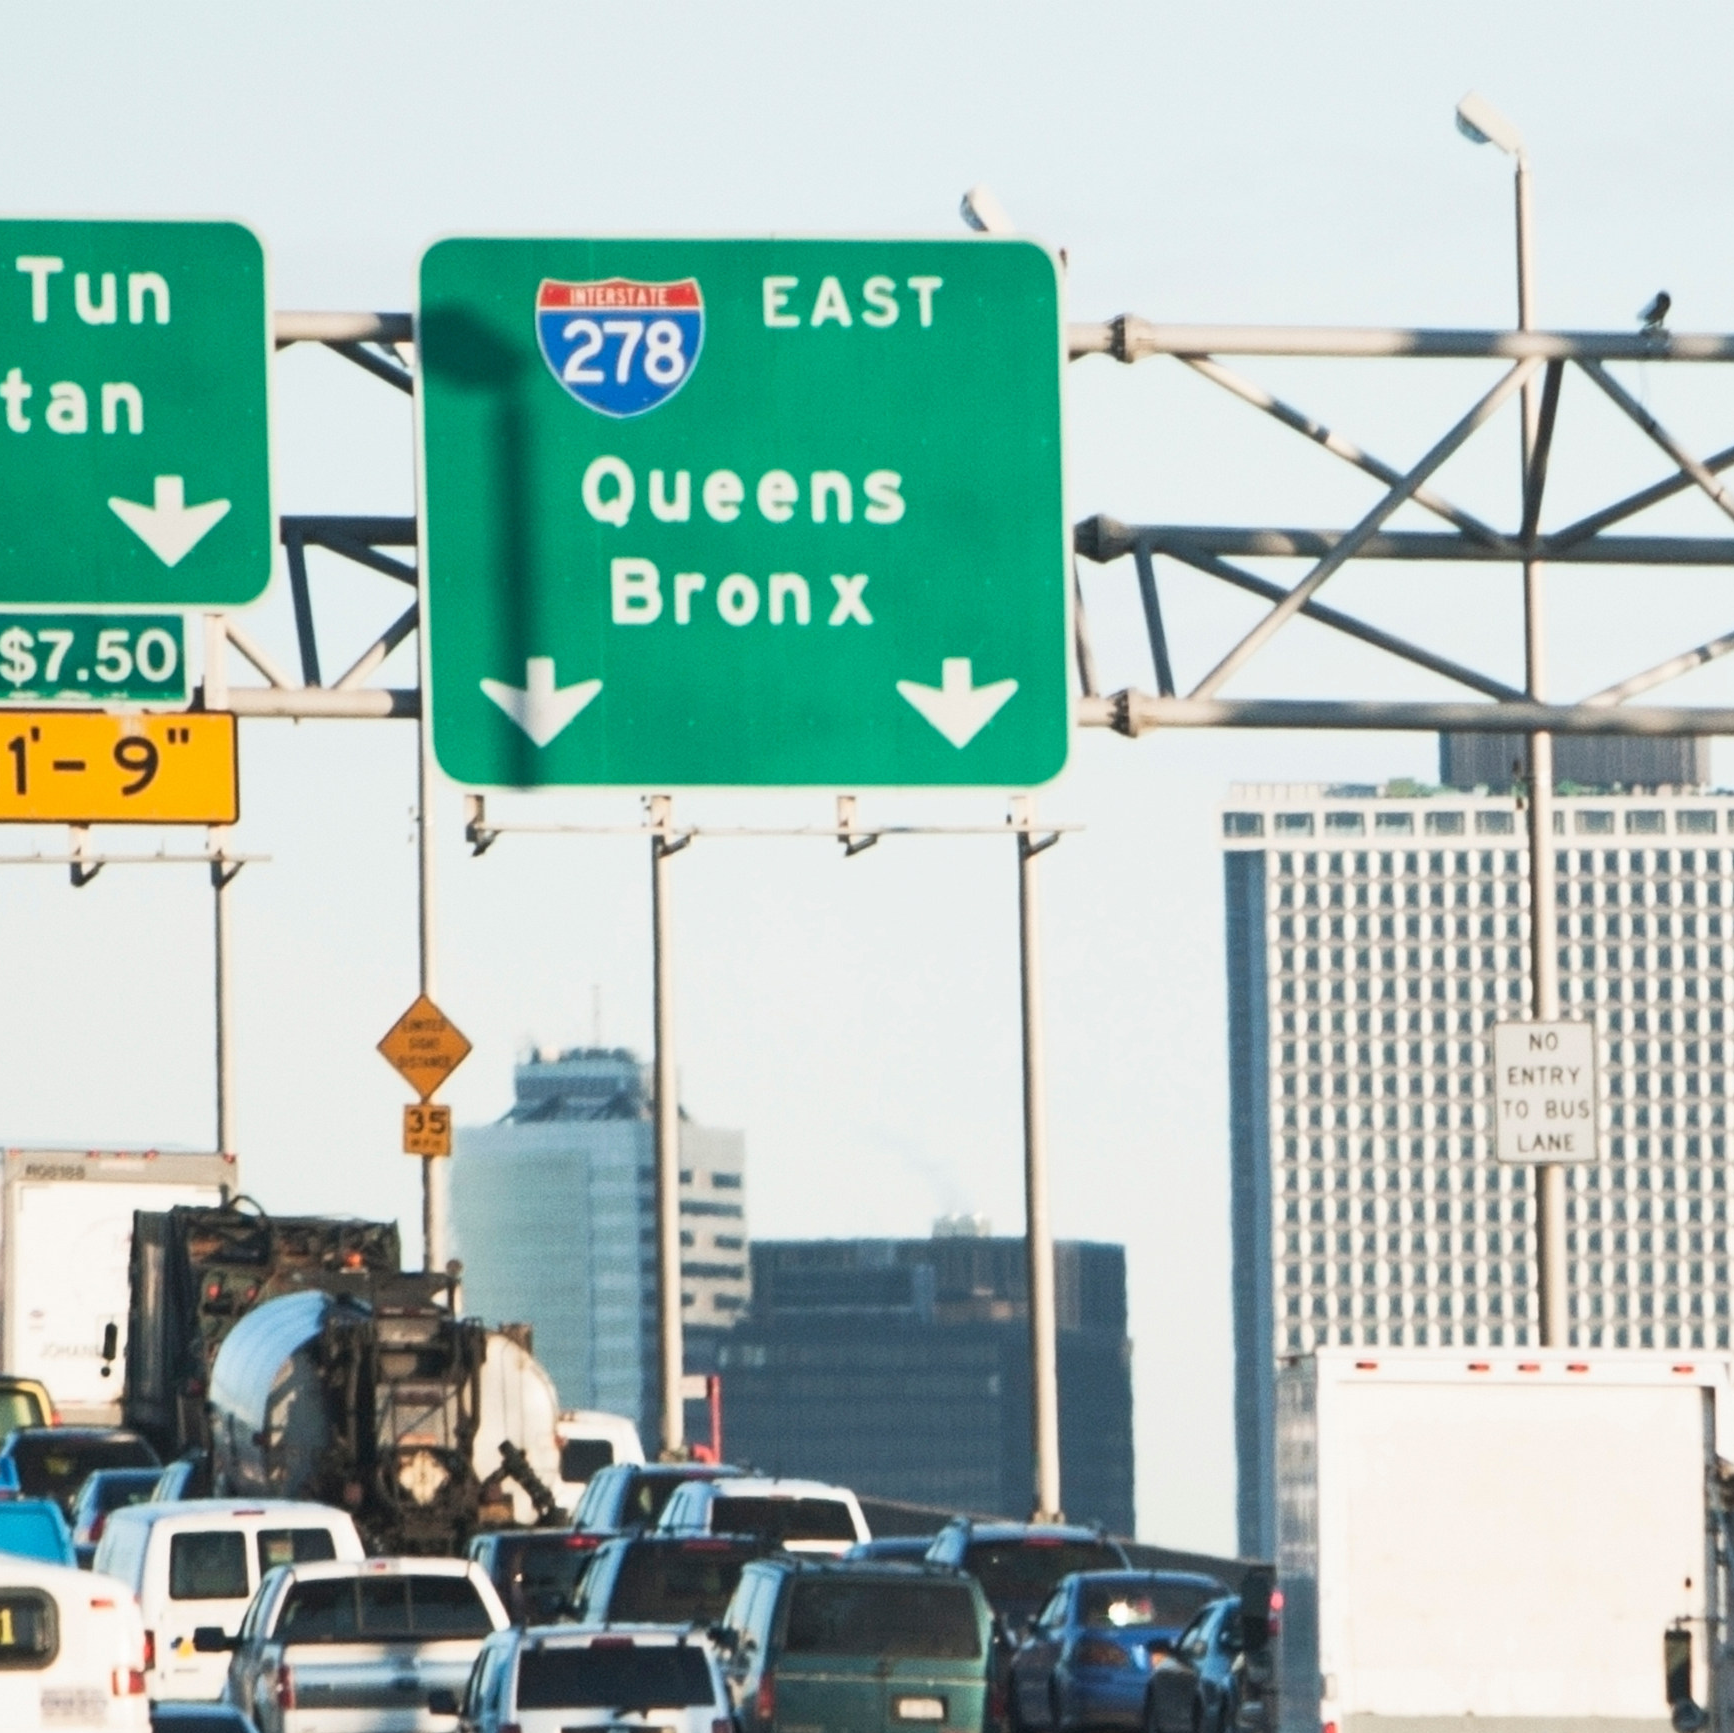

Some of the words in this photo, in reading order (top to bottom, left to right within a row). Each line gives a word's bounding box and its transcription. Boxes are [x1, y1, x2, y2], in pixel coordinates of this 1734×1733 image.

[15, 255, 172, 325] Tun
[569, 286, 668, 306] INTERSTATE
[761, 275, 945, 328] EAST
[562, 318, 686, 385] 278
[580, 454, 907, 529] Queens
[609, 556, 875, 627] Bronx
[1528, 1031, 1559, 1051] NO
[1507, 1065, 1581, 1086] ENTRY
[409, 1108, 448, 1134] 35
[1502, 1099, 1529, 1119] TO
[1545, 1099, 1591, 1120] BUS
[1517, 1132, 1576, 1153] LANE
